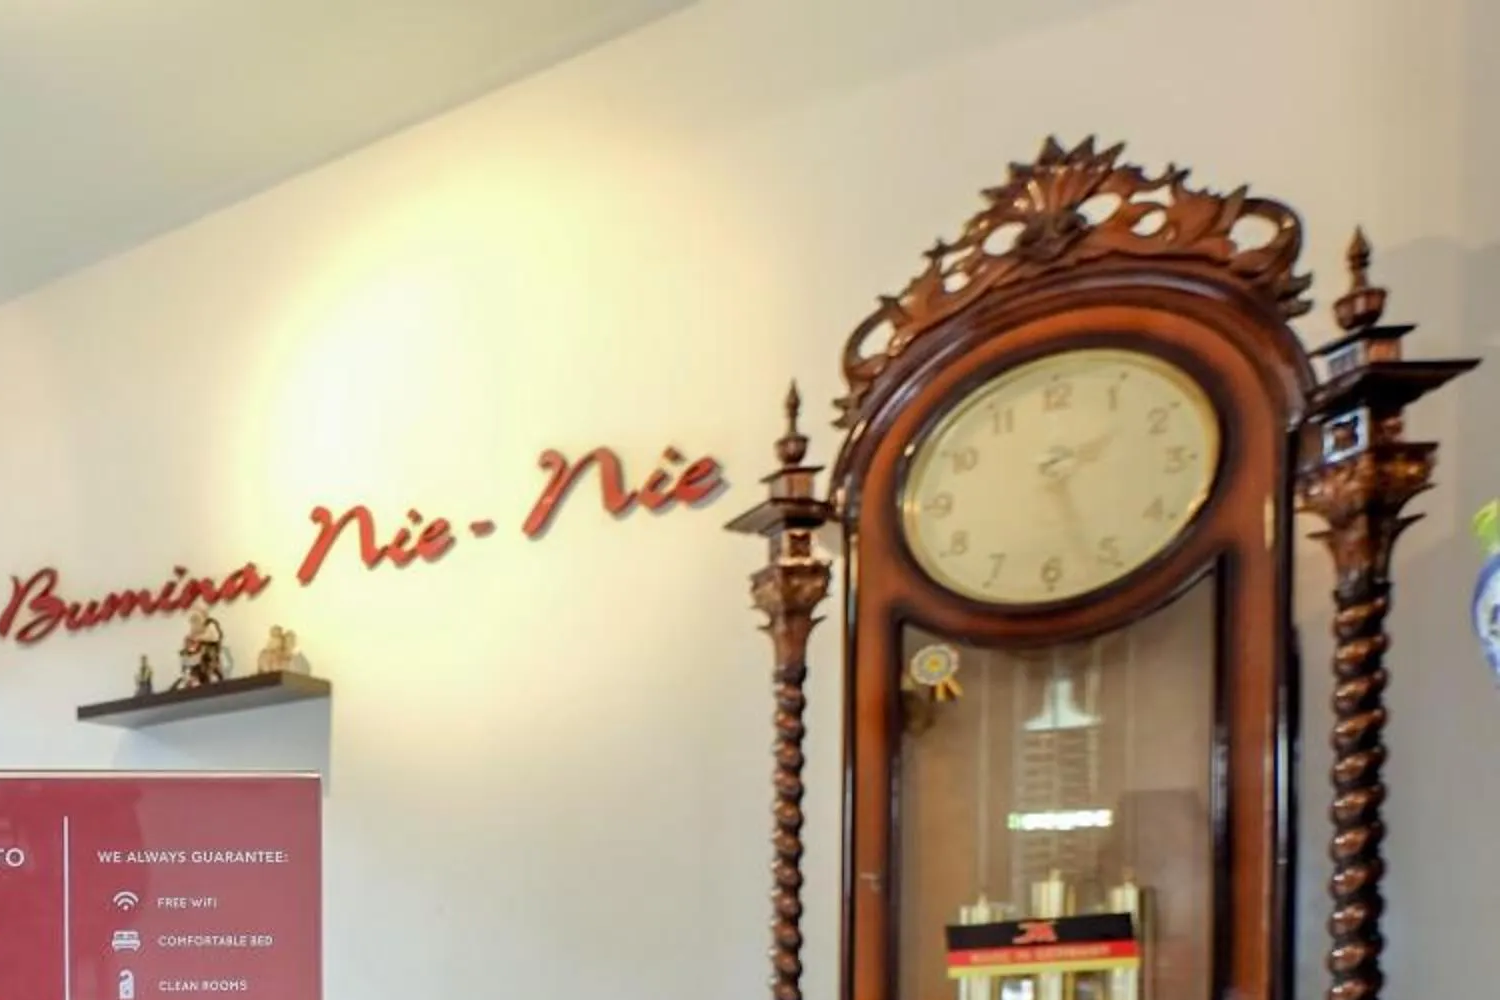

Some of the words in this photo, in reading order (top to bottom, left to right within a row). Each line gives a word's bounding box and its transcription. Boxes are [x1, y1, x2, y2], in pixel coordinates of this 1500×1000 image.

[1042, 384, 1074, 412] 12
[1108, 386, 1120, 412] 1
[992, 409, 1016, 435] 11
[1148, 408, 1171, 435] 2
[952, 446, 980, 475] 10
[1164, 446, 1188, 474] 3
[934, 494, 953, 519] 9
[1142, 498, 1164, 522] 4
[950, 532, 970, 556] 8
[1040, 559, 1064, 586] 6
[98, 851, 121, 863] WE
[127, 851, 186, 863] ALWAYS
[191, 851, 289, 863] GUARANTEE:
[157, 897, 186, 909] FREE
[157, 935, 247, 947] COMFORTABLE
[250, 935, 274, 947] BED
[158, 980, 199, 992] CLEAN
[201, 980, 248, 992] ROOMS
